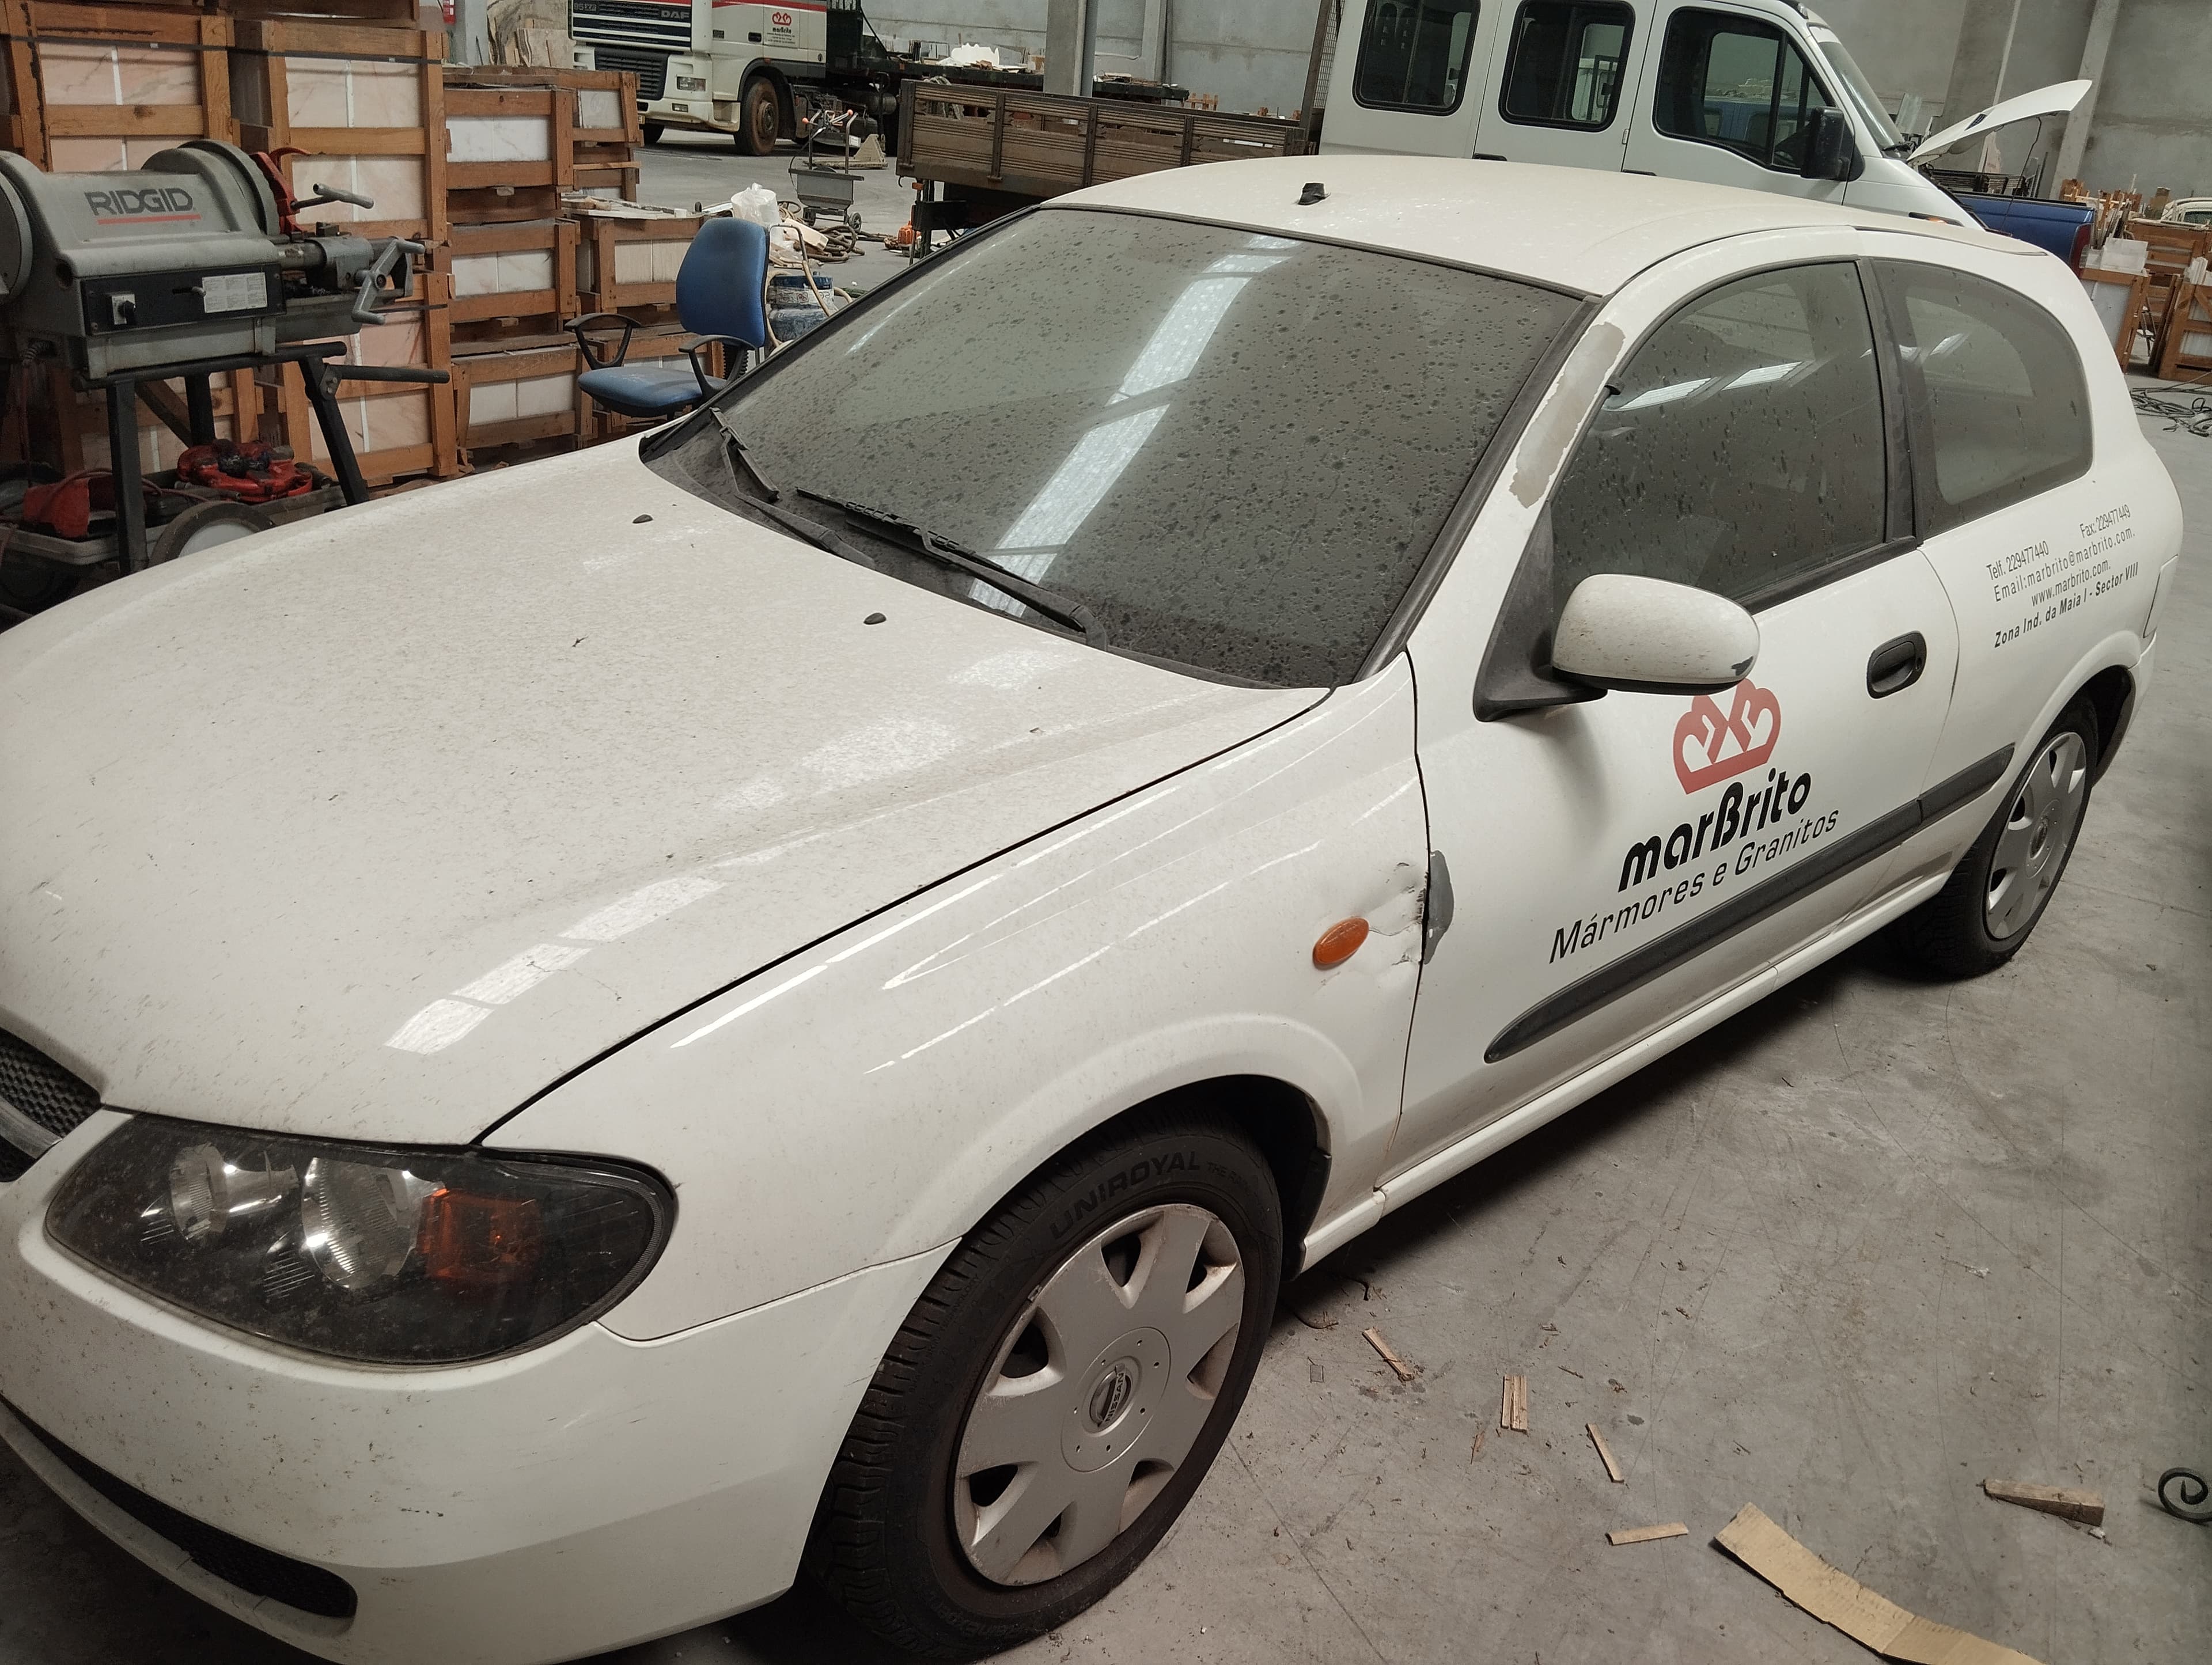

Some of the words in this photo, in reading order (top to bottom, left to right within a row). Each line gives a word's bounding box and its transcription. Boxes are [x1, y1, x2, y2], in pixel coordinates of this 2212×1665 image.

[661, 10, 690, 19] DAF
[84, 188, 194, 215] RIDGID
[1986, 560, 2006, 581] Telf.
[2006, 541, 2049, 572] 229477440
[2080, 523, 2096, 538] Fax:
[2096, 504, 2131, 532] 229477449
[1994, 625, 2020, 648] Zona
[2023, 612, 2041, 633] Ind.
[2046, 606, 2056, 622] da
[2059, 593, 2081, 615] Maia
[2096, 573, 2123, 597] Sector
[2125, 562, 2139, 581] VIII
[2031, 560, 2111, 606] www.marbrito.com.
[1618, 768, 1811, 893] marBrito
[1549, 871, 1705, 964] Mármores
[1713, 862, 1728, 887] e
[1734, 809, 1839, 876] Granitos
[1050, 1151, 1201, 1239] UNIROYAL
[1105, 1372, 1124, 1421] NISSAN
